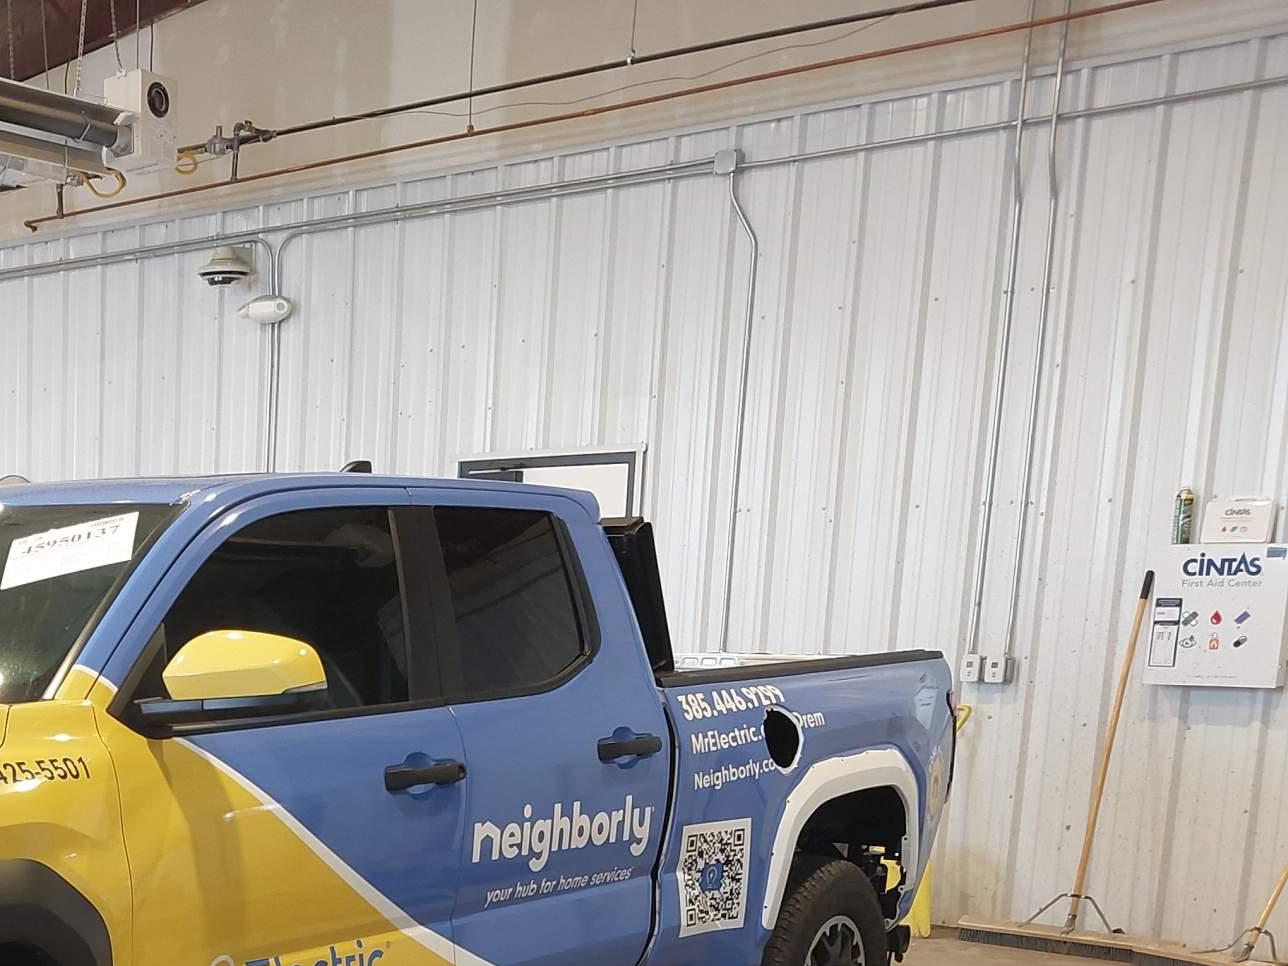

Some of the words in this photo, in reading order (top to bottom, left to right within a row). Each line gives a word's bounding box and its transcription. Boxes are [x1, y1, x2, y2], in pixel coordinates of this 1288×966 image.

[21, 525, 121, 555] 45950137
[1182, 552, 1262, 576] CINTAS
[1182, 579, 1203, 587] First
[1206, 579, 1224, 587] Aid
[1228, 579, 1263, 587] Center
[677, 684, 786, 721] 385.446.9299
[471, 794, 652, 873] neighborly
[484, 887, 513, 909] your
[514, 880, 538, 899] hub
[539, 877, 558, 895] for
[558, 875, 589, 891] home
[590, 866, 632, 886] services
